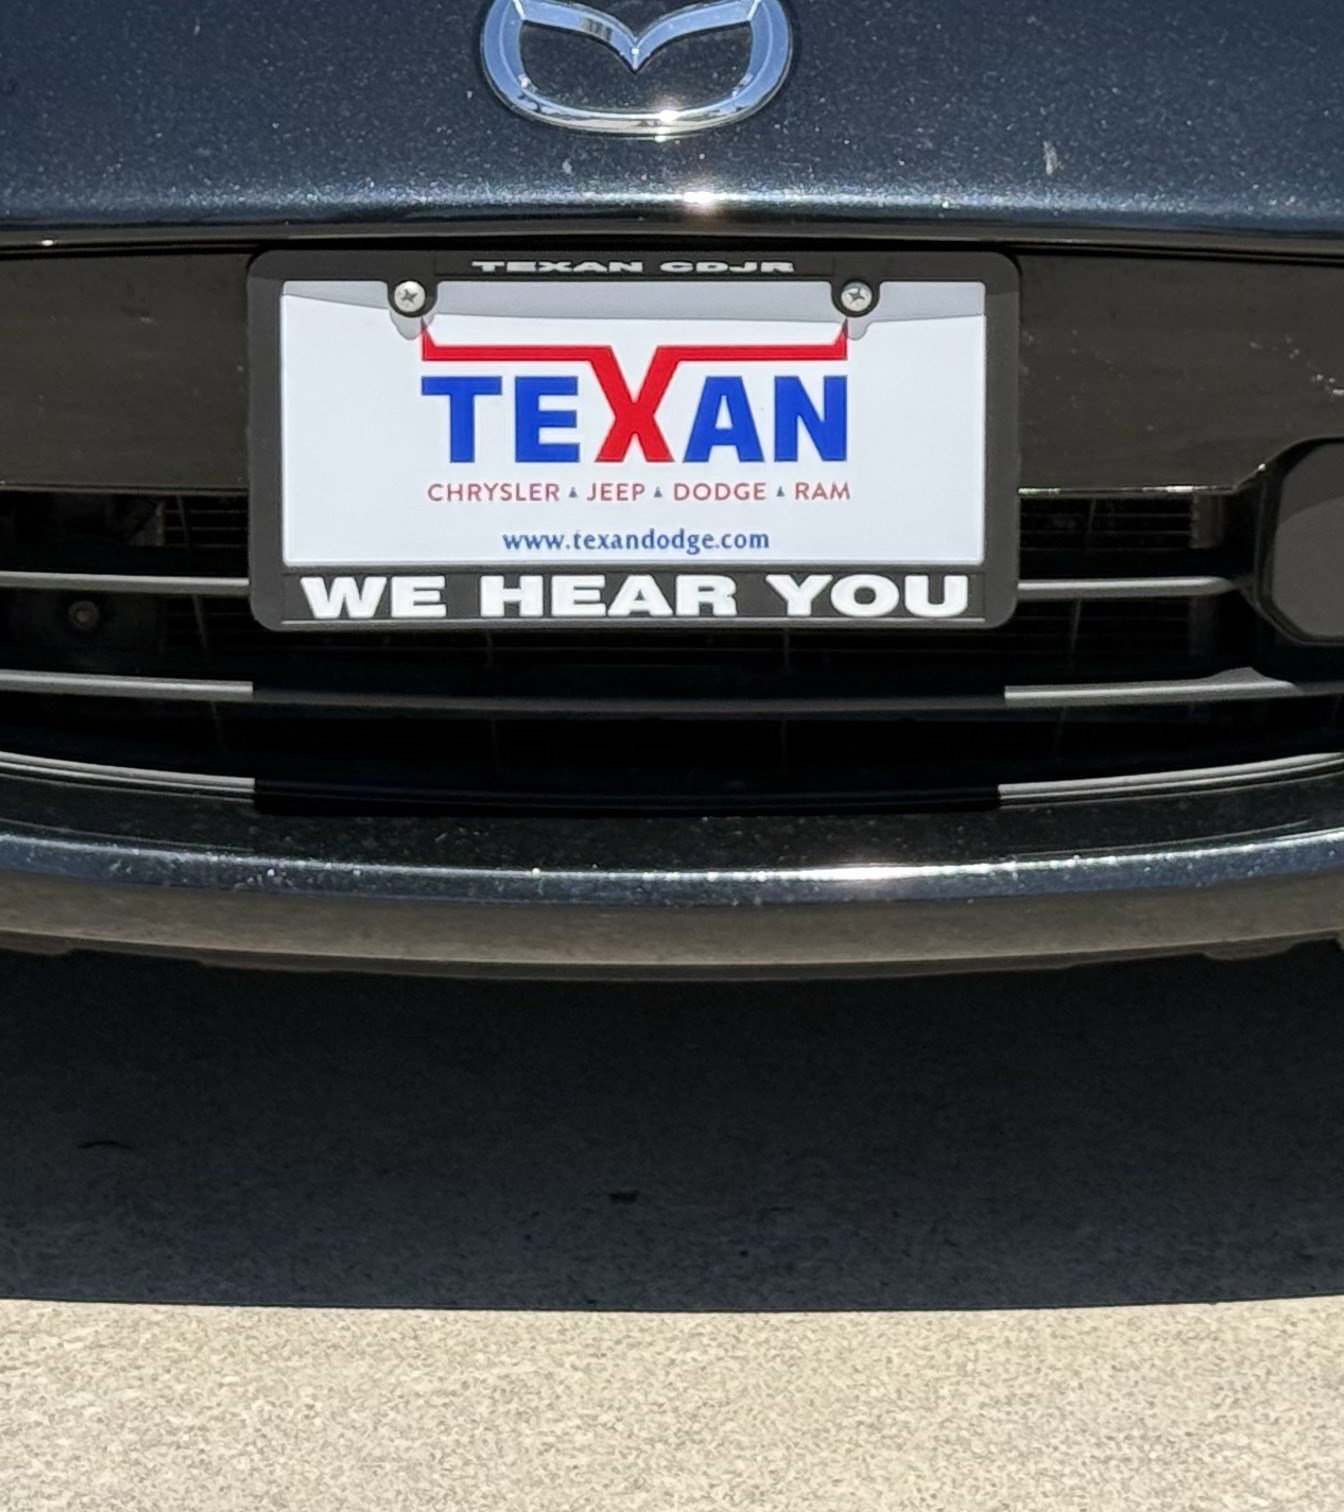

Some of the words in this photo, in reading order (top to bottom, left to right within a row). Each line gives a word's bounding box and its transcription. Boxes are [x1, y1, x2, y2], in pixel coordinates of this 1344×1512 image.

[471, 260, 643, 274] TEXAN
[659, 260, 795, 274] CDJR
[421, 318, 848, 463] TEXAN
[427, 482, 560, 502] CHRYSLER
[586, 482, 646, 502] JEEP
[673, 482, 767, 502] DODGE
[794, 481, 851, 501] RAM
[501, 527, 770, 556] www.texandodge.com
[301, 574, 448, 619] WE
[480, 574, 740, 617] HEAR
[764, 573, 969, 616] YOU
